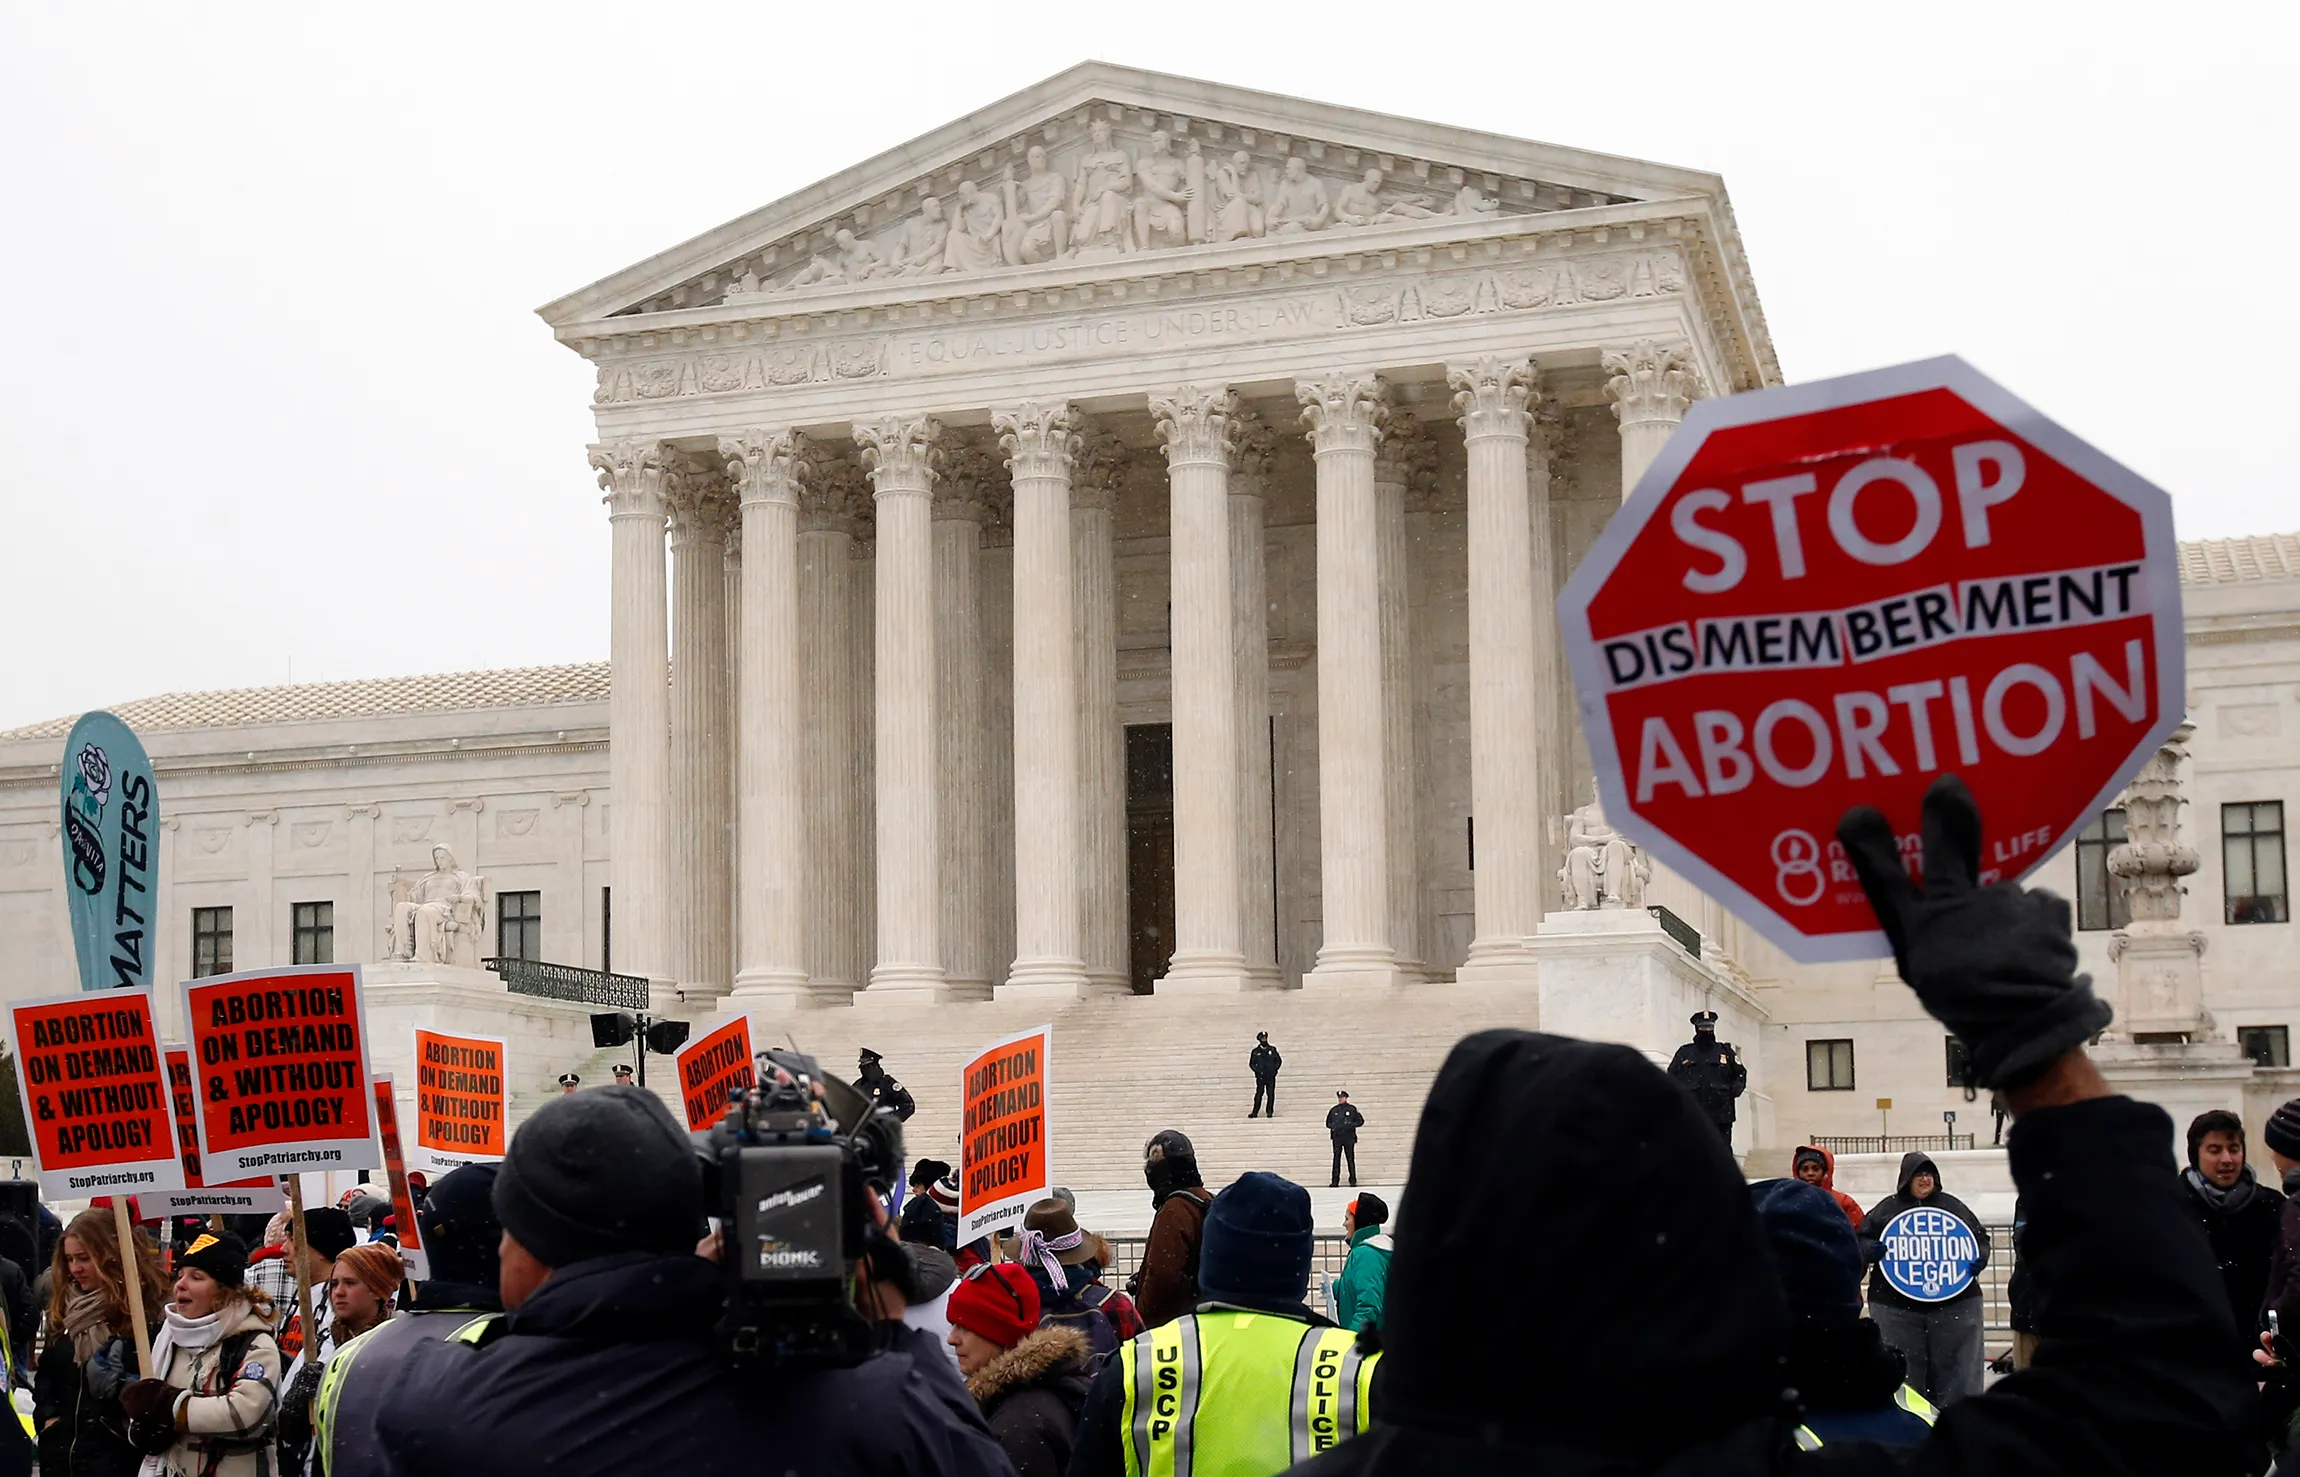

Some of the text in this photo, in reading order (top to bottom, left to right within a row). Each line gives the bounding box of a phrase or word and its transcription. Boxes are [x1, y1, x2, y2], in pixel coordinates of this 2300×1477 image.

[910, 300, 1315, 366] EQUAL JUSTICE UNDER LAW
[1670, 439, 2027, 594] STOP
[1603, 565, 2141, 687] DISMEMBERMENT
[1635, 638, 2148, 804] ABORTION
[1993, 826, 2052, 863] LIFE
[211, 987, 344, 1028] ABORTION
[34, 1009, 143, 1048] ABORTION
[203, 1023, 354, 1065] ON DEMAND
[28, 1054, 62, 1084] ON
[66, 1045, 155, 1080] DEMAND
[425, 1041, 496, 1070] ABORTION
[685, 1032, 745, 1091] ABORTION
[209, 1075, 229, 1102] &
[234, 1061, 356, 1097] WITHOUT
[420, 1065, 500, 1095] ON DEMAND
[968, 1049, 1036, 1102] ABORTION
[36, 1095, 56, 1121] &
[59, 1082, 159, 1118] WITHOUT
[229, 1097, 344, 1135] APOLOGY
[421, 1093, 500, 1121] & WITHOUT
[688, 1092, 706, 1125] ON
[964, 1080, 1040, 1136] ON DEMAND
[57, 1118, 152, 1154] APOLOGY
[428, 1118, 491, 1145] APOLOGY
[964, 1116, 1041, 1170] & WITHOUT
[238, 1150, 342, 1168] StopPatriarchy.org
[969, 1151, 1031, 1200] APOLOGY
[69, 1171, 154, 1189] StopPatriarchy.org
[170, 1195, 252, 1207] StopPatriarchy.org
[970, 1202, 1025, 1231] StopPatriarchy.org
[1898, 1212, 1957, 1236] KEEP
[1885, 1235, 1973, 1261] ABORTION
[1894, 1261, 1967, 1286] LEGAL
[1151, 1346, 1178, 1440] USCP
[1312, 1350, 1339, 1452] POLICE
